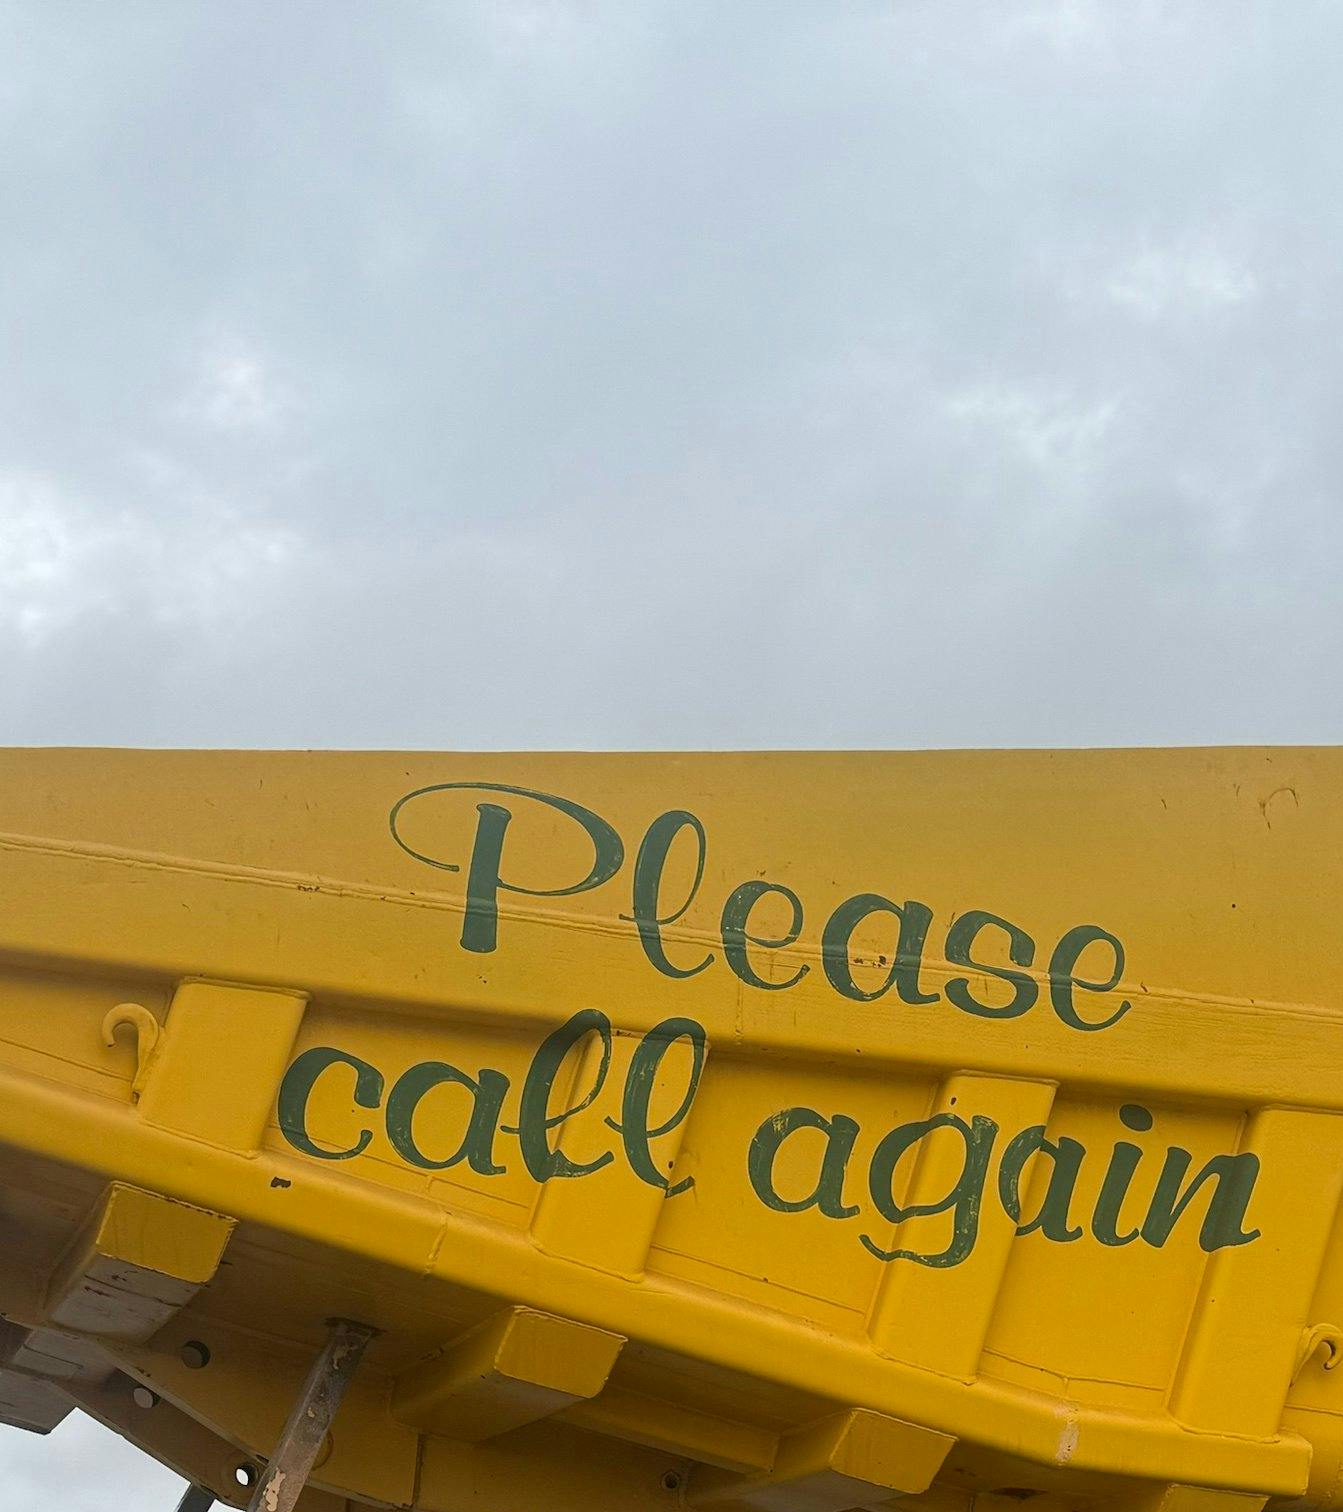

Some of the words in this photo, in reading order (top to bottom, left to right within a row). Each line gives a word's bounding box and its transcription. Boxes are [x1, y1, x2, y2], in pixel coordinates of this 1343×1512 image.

[390, 782, 1131, 1030] Please
[278, 1009, 707, 1197] call
[748, 1103, 1261, 1267] again
